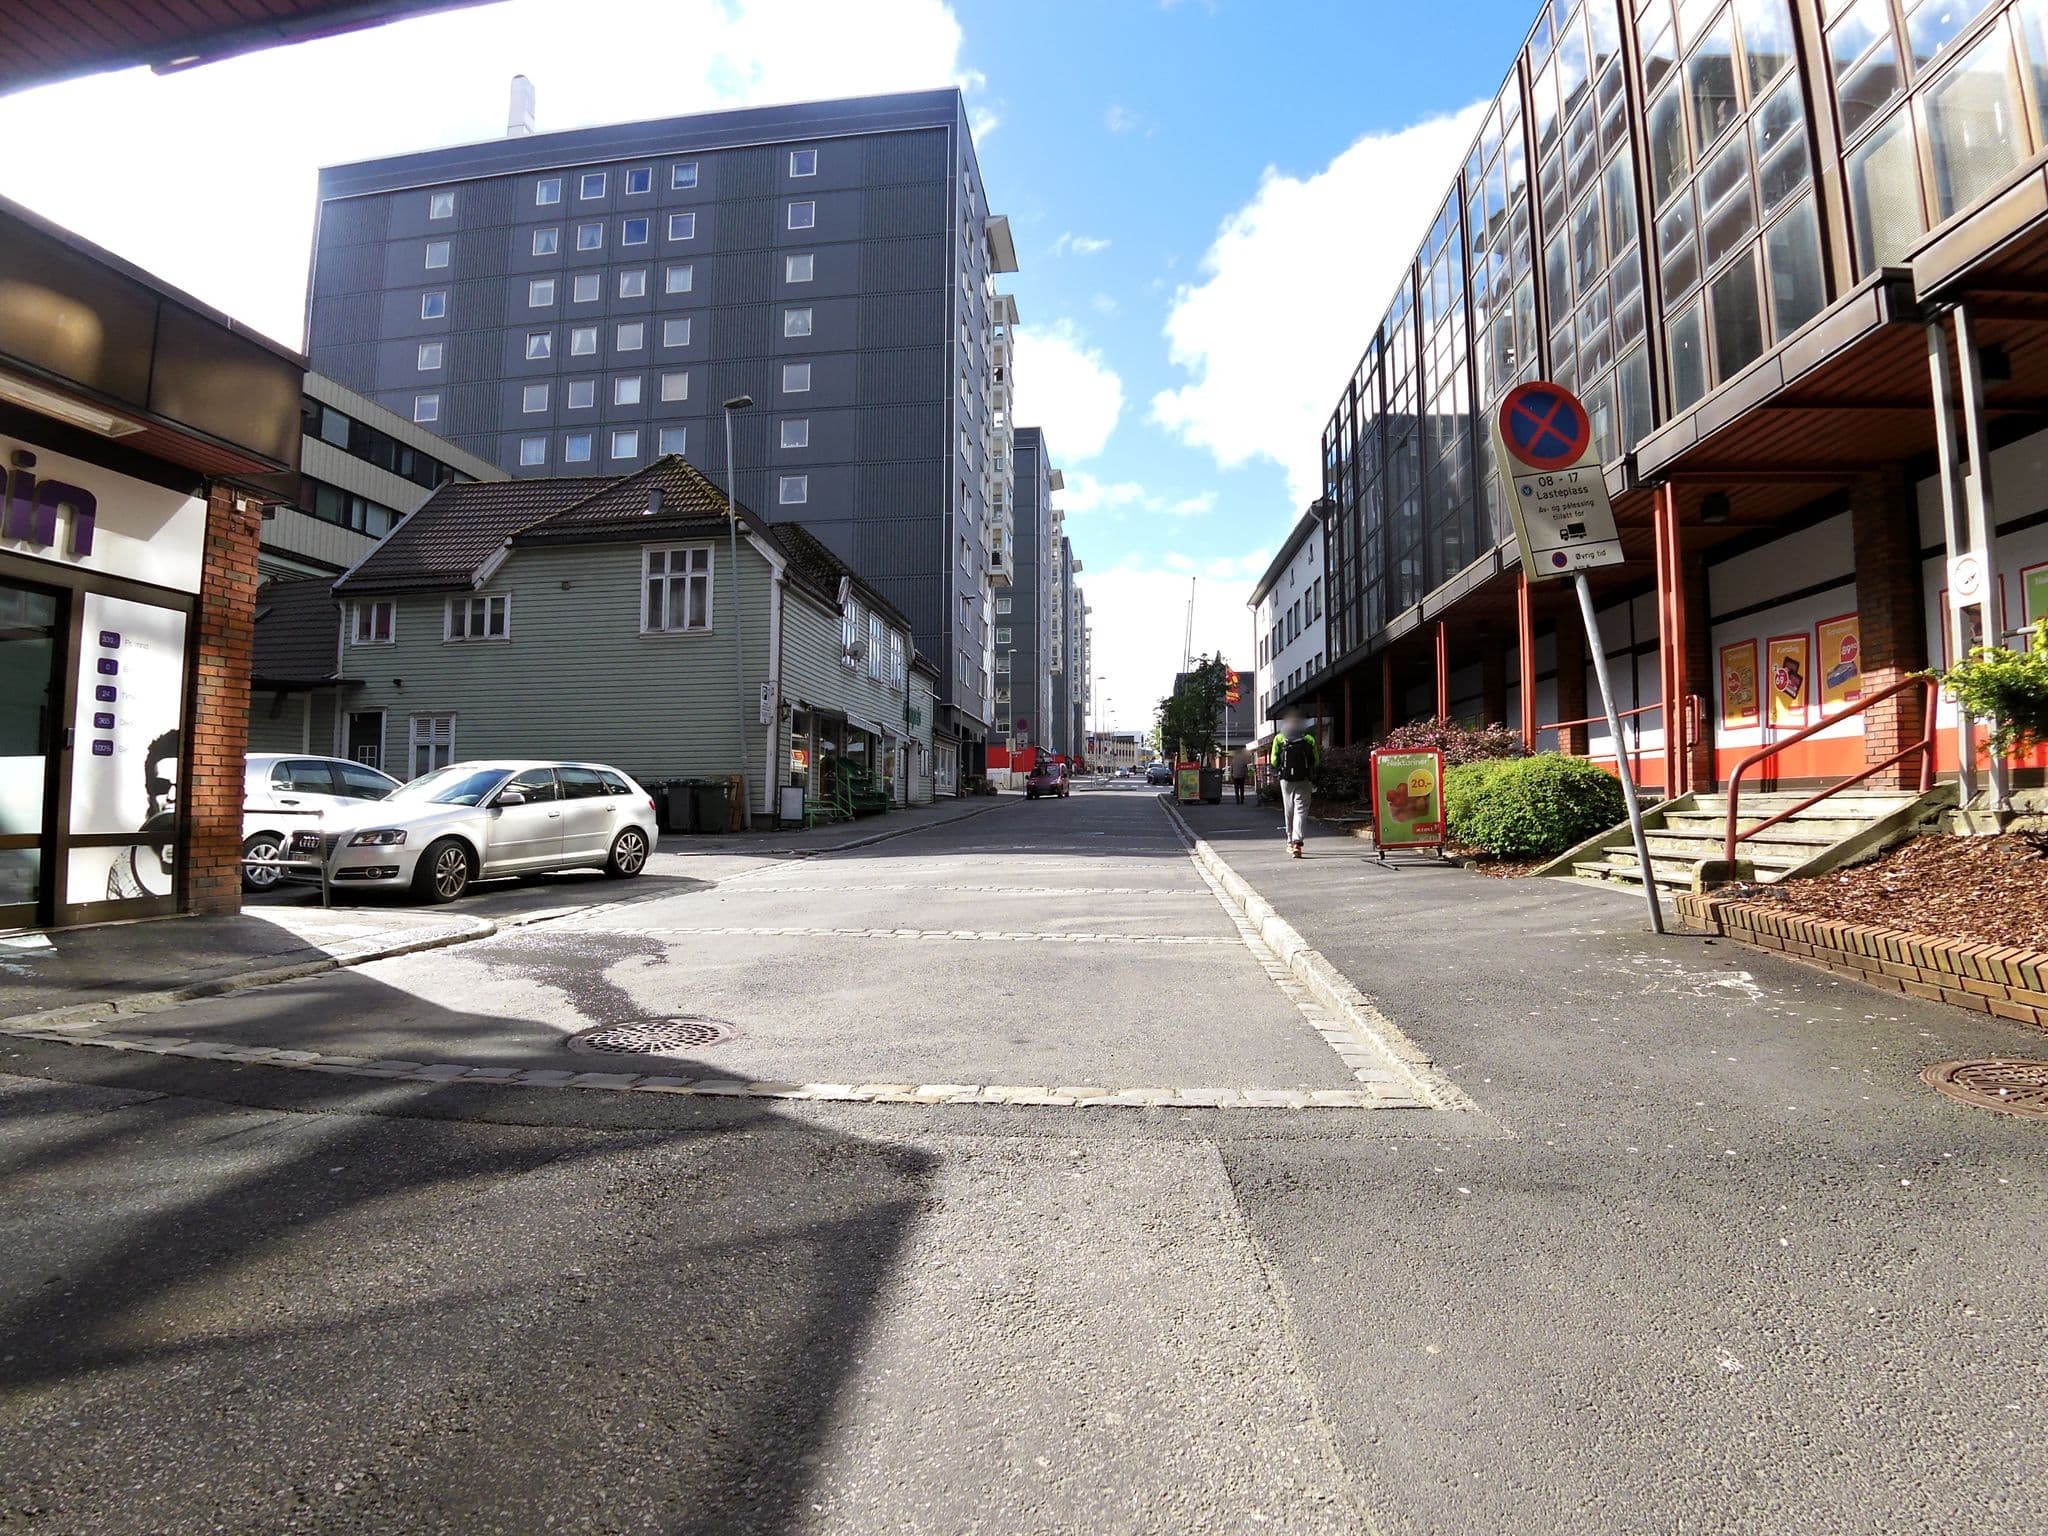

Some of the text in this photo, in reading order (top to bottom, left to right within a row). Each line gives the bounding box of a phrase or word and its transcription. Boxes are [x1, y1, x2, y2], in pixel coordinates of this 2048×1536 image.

[1538, 475, 1554, 487] 08
[1567, 472, 1578, 483] 17
[1536, 486, 1589, 500] Lasteplass
[1551, 504, 1560, 512] og
[1575, 551, 1595, 560] Øvrig
